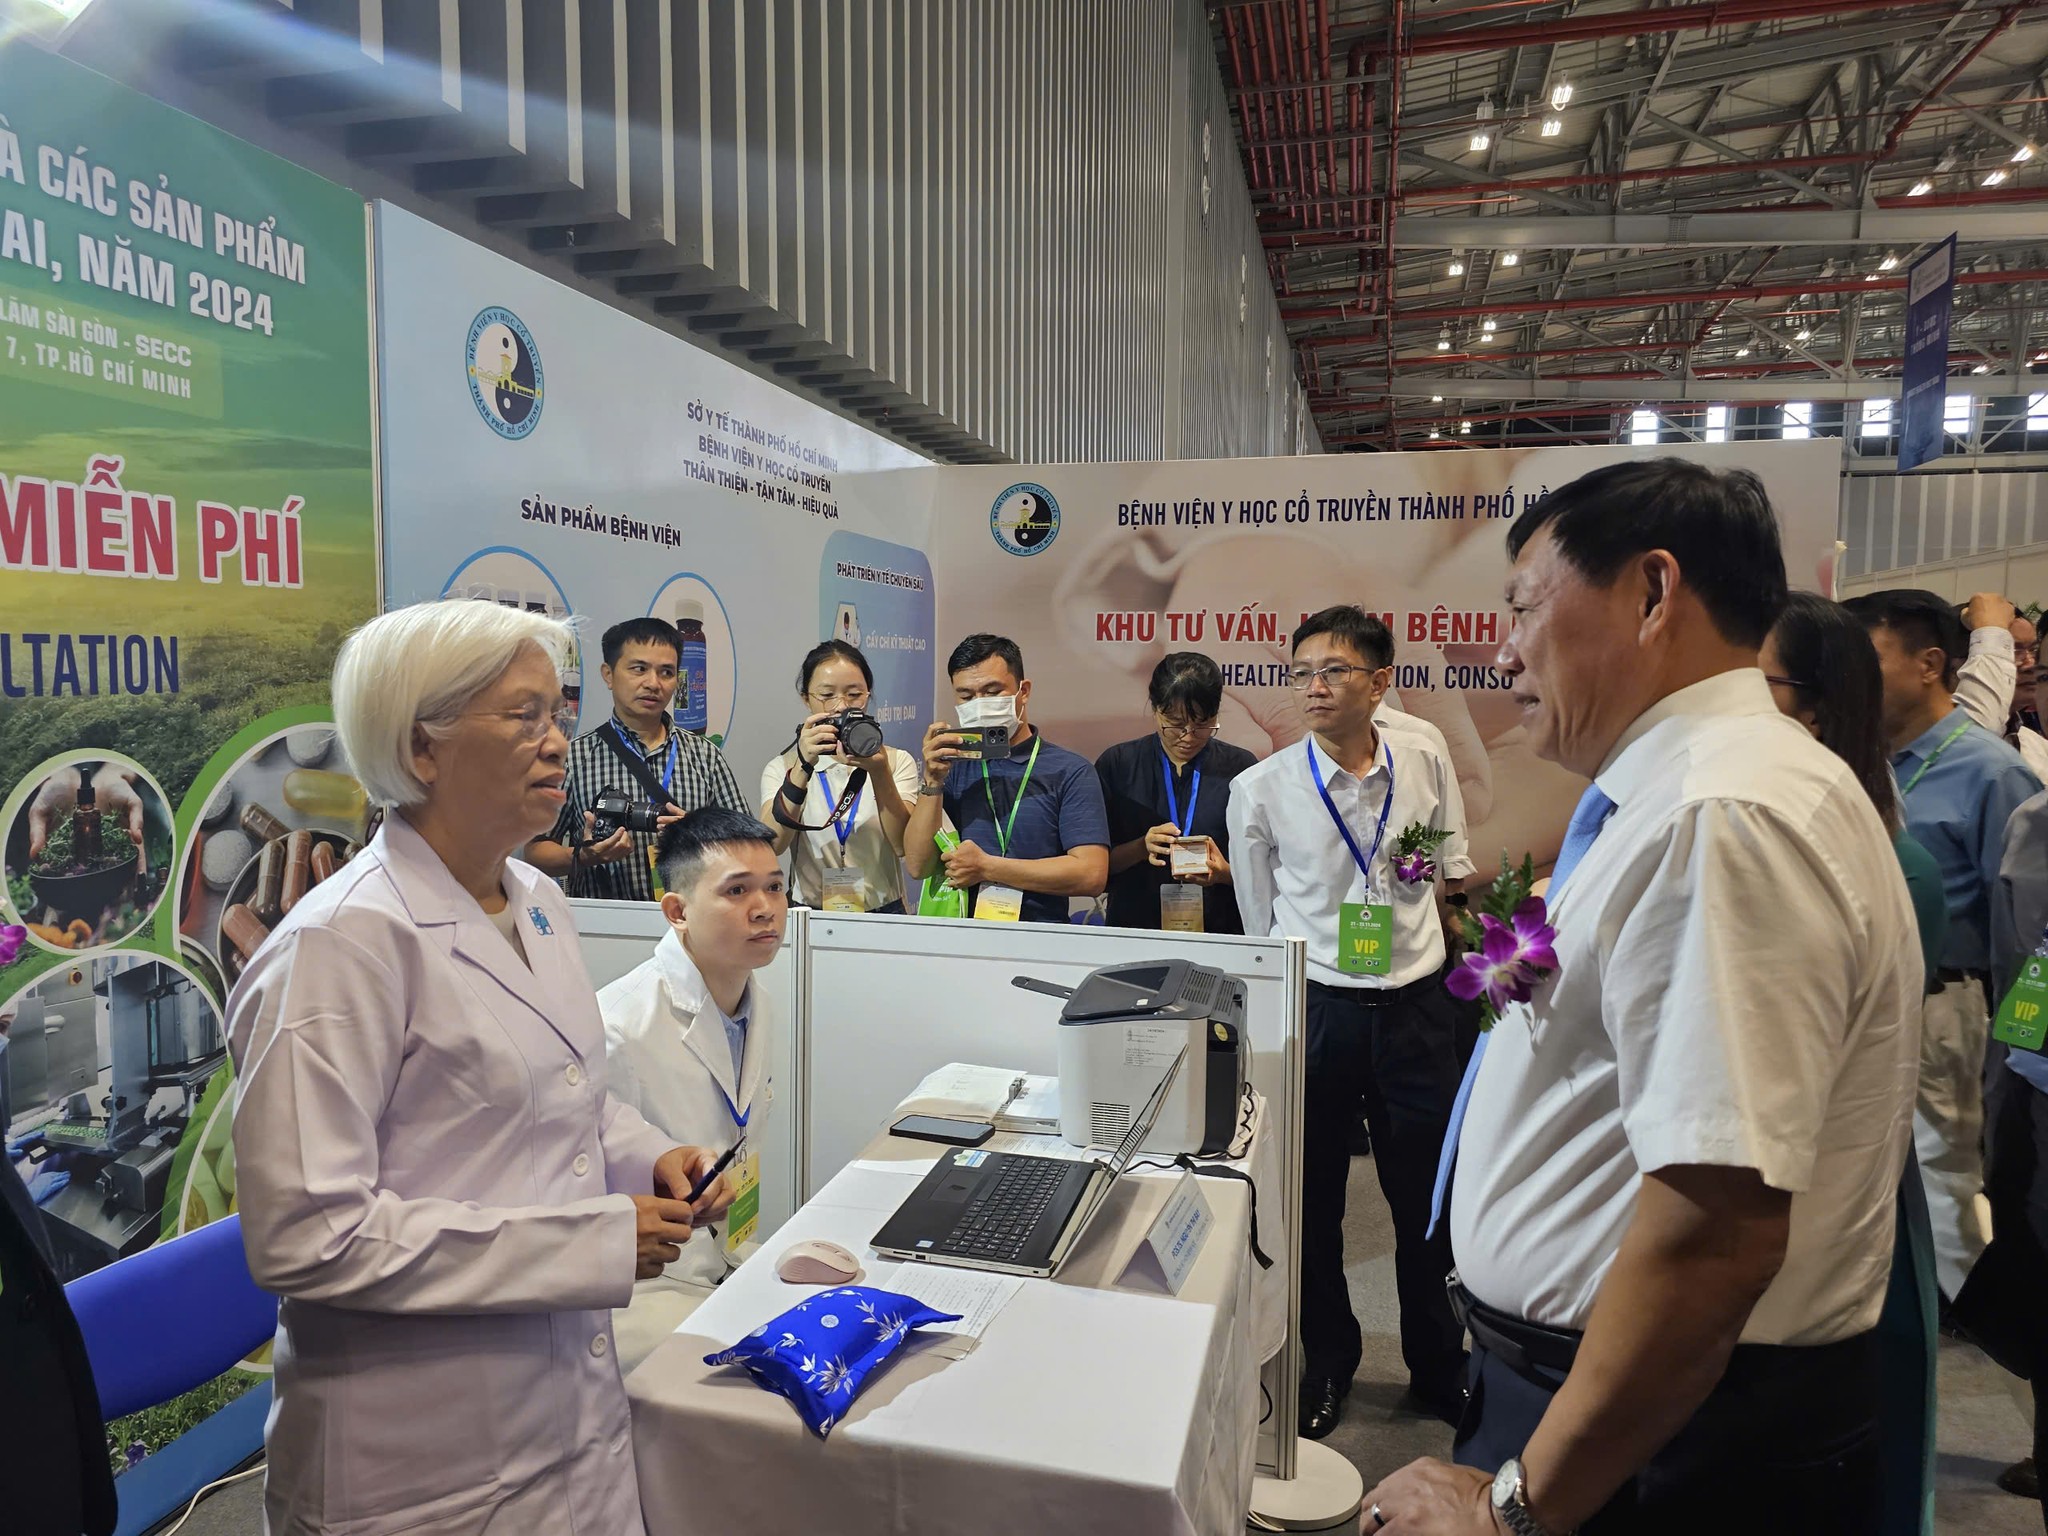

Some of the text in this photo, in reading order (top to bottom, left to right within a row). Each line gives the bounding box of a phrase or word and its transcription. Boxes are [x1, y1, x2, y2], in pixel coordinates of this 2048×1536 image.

[38, 145, 117, 217] CÁC
[129, 174, 203, 248] SẢN
[214, 211, 305, 285] PHẨM
[1, 209, 273, 336] AI, NĂM 2024
[46, 308, 76, 338] SÀI
[82, 316, 118, 349] GÒN
[135, 334, 192, 367] SECC
[102, 361, 134, 386] CHÍ
[142, 369, 191, 398] MINH
[687, 398, 838, 473] SỞ Y TẾ THÀNH PHỐ HỒ CHÍ MINH
[683, 459, 715, 484] THÂN
[718, 469, 748, 495] THIỆN
[756, 480, 775, 503] TẬN
[777, 486, 795, 507] TÂM
[802, 495, 821, 516] HIỆU
[823, 501, 839, 520] QUẢ
[699, 434, 831, 494] BỆNH VIỆN Y HỌC CỔ TRUYỀN
[0, 456, 303, 587] MIỄN PHÍ
[521, 494, 681, 550] SẢN PHẨM BỆNH VIỆN
[1118, 500, 1166, 530] BỆNH
[1174, 498, 1215, 529] VIỆN
[1222, 501, 1233, 524] Y
[1240, 499, 1277, 527] HỌC
[1284, 489, 1310, 523] CỔ
[1317, 489, 1391, 522] TRUYỀN
[1398, 492, 1465, 520] THÀNH
[1473, 485, 1515, 519] PHỐ
[837, 561, 856, 578] PHÁT
[876, 571, 881, 583] Y
[882, 567, 889, 585] TẾ
[1096, 613, 1155, 642] KHU
[1166, 609, 1207, 642] TƯ
[1216, 602, 1287, 648] VẤN,
[1407, 604, 1498, 650] BỆNH
[1, 633, 179, 698] LTATION
[1222, 664, 1290, 687] HEALTH
[839, 790, 855, 811] EOS
[1354, 939, 1379, 954] VIP
[2014, 1000, 2040, 1021] VIP
